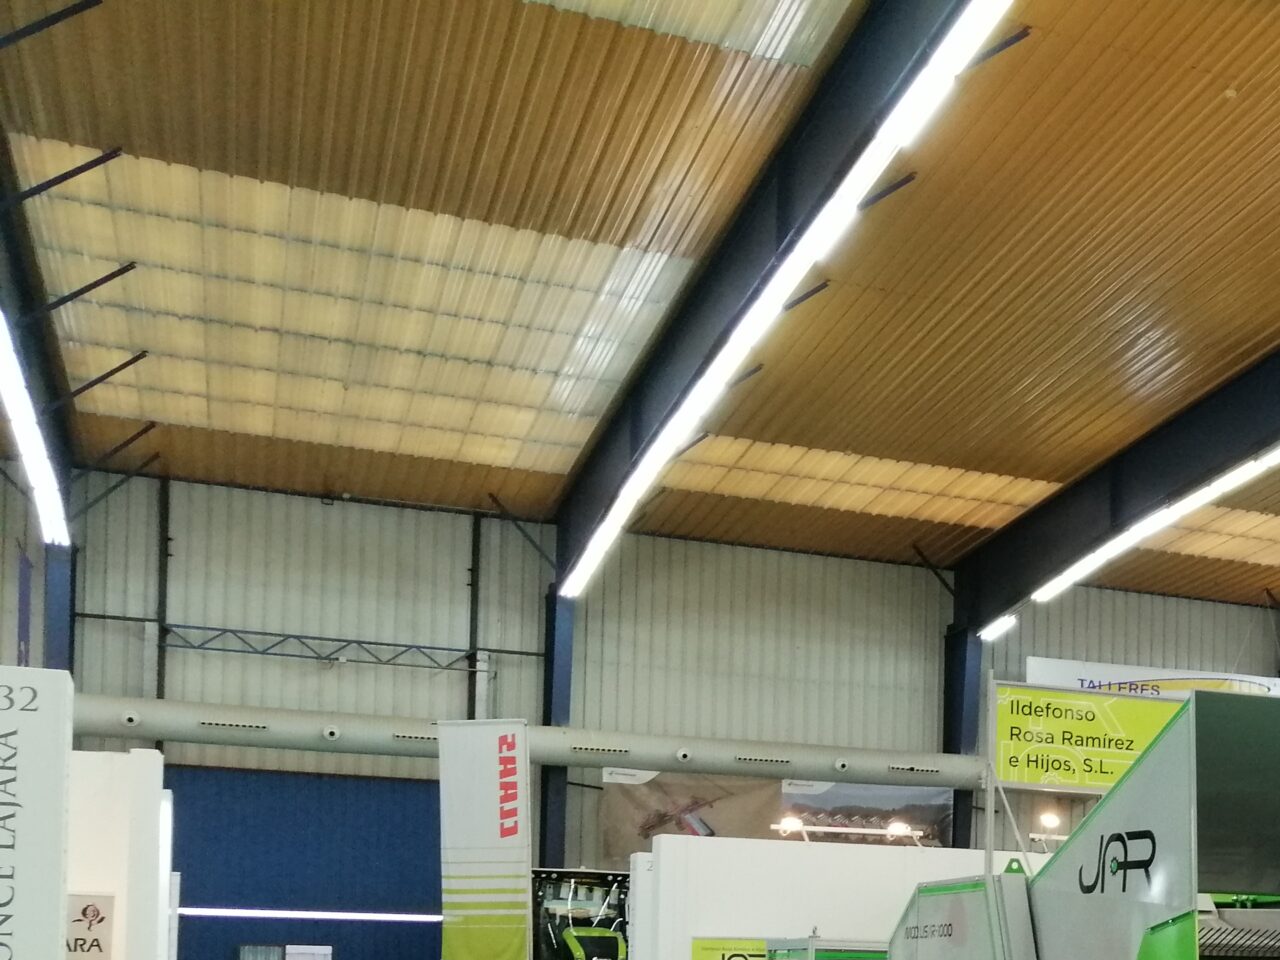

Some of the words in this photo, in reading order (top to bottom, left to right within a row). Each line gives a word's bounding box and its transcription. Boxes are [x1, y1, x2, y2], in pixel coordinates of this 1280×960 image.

[1009, 699, 1096, 722] Ildefonso
[1009, 726, 1055, 745] Rosa
[1061, 732, 1135, 751] Ramírez
[1008, 754, 1020, 768] e
[1026, 753, 1076, 775] Hijos,
[1082, 758, 1115, 775] S.L.
[1078, 829, 1157, 895] JAR
